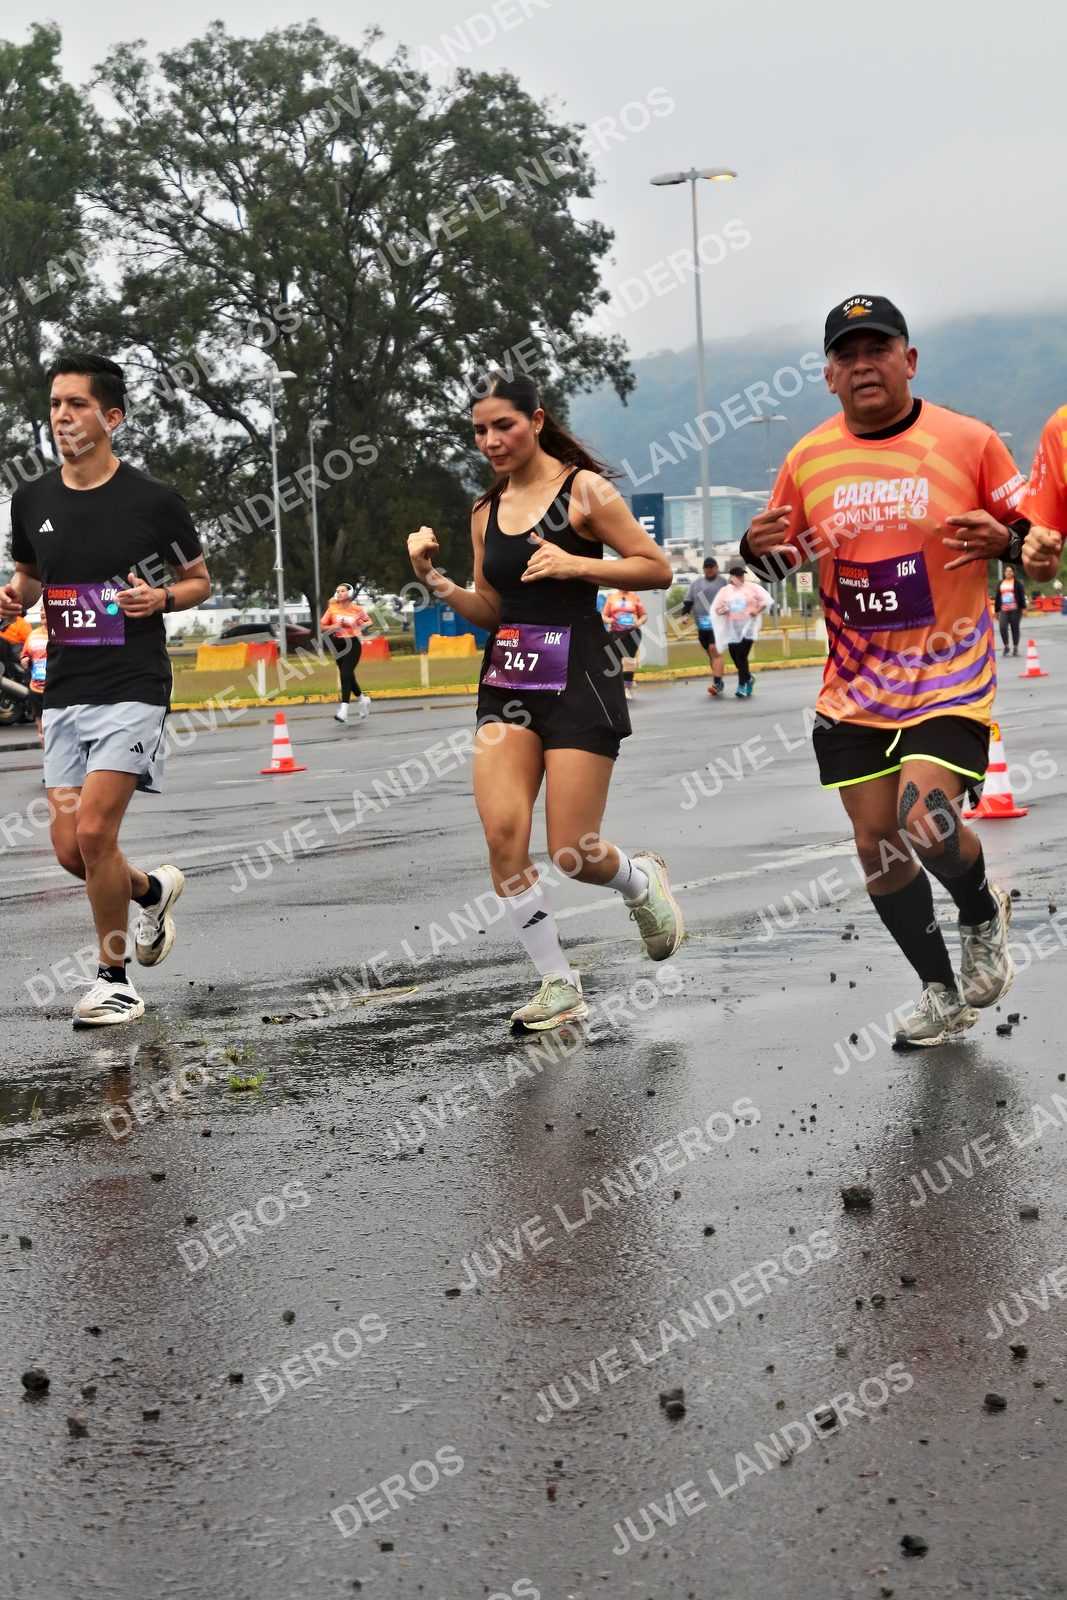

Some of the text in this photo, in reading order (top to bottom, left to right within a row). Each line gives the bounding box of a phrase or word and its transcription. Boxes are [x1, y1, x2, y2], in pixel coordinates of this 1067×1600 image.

[833, 478, 929, 509] CARRERA
[47, 588, 78, 599] CARRERA
[855, 590, 899, 612] 143
[61, 610, 97, 628] 132
[504, 651, 540, 672] 247
